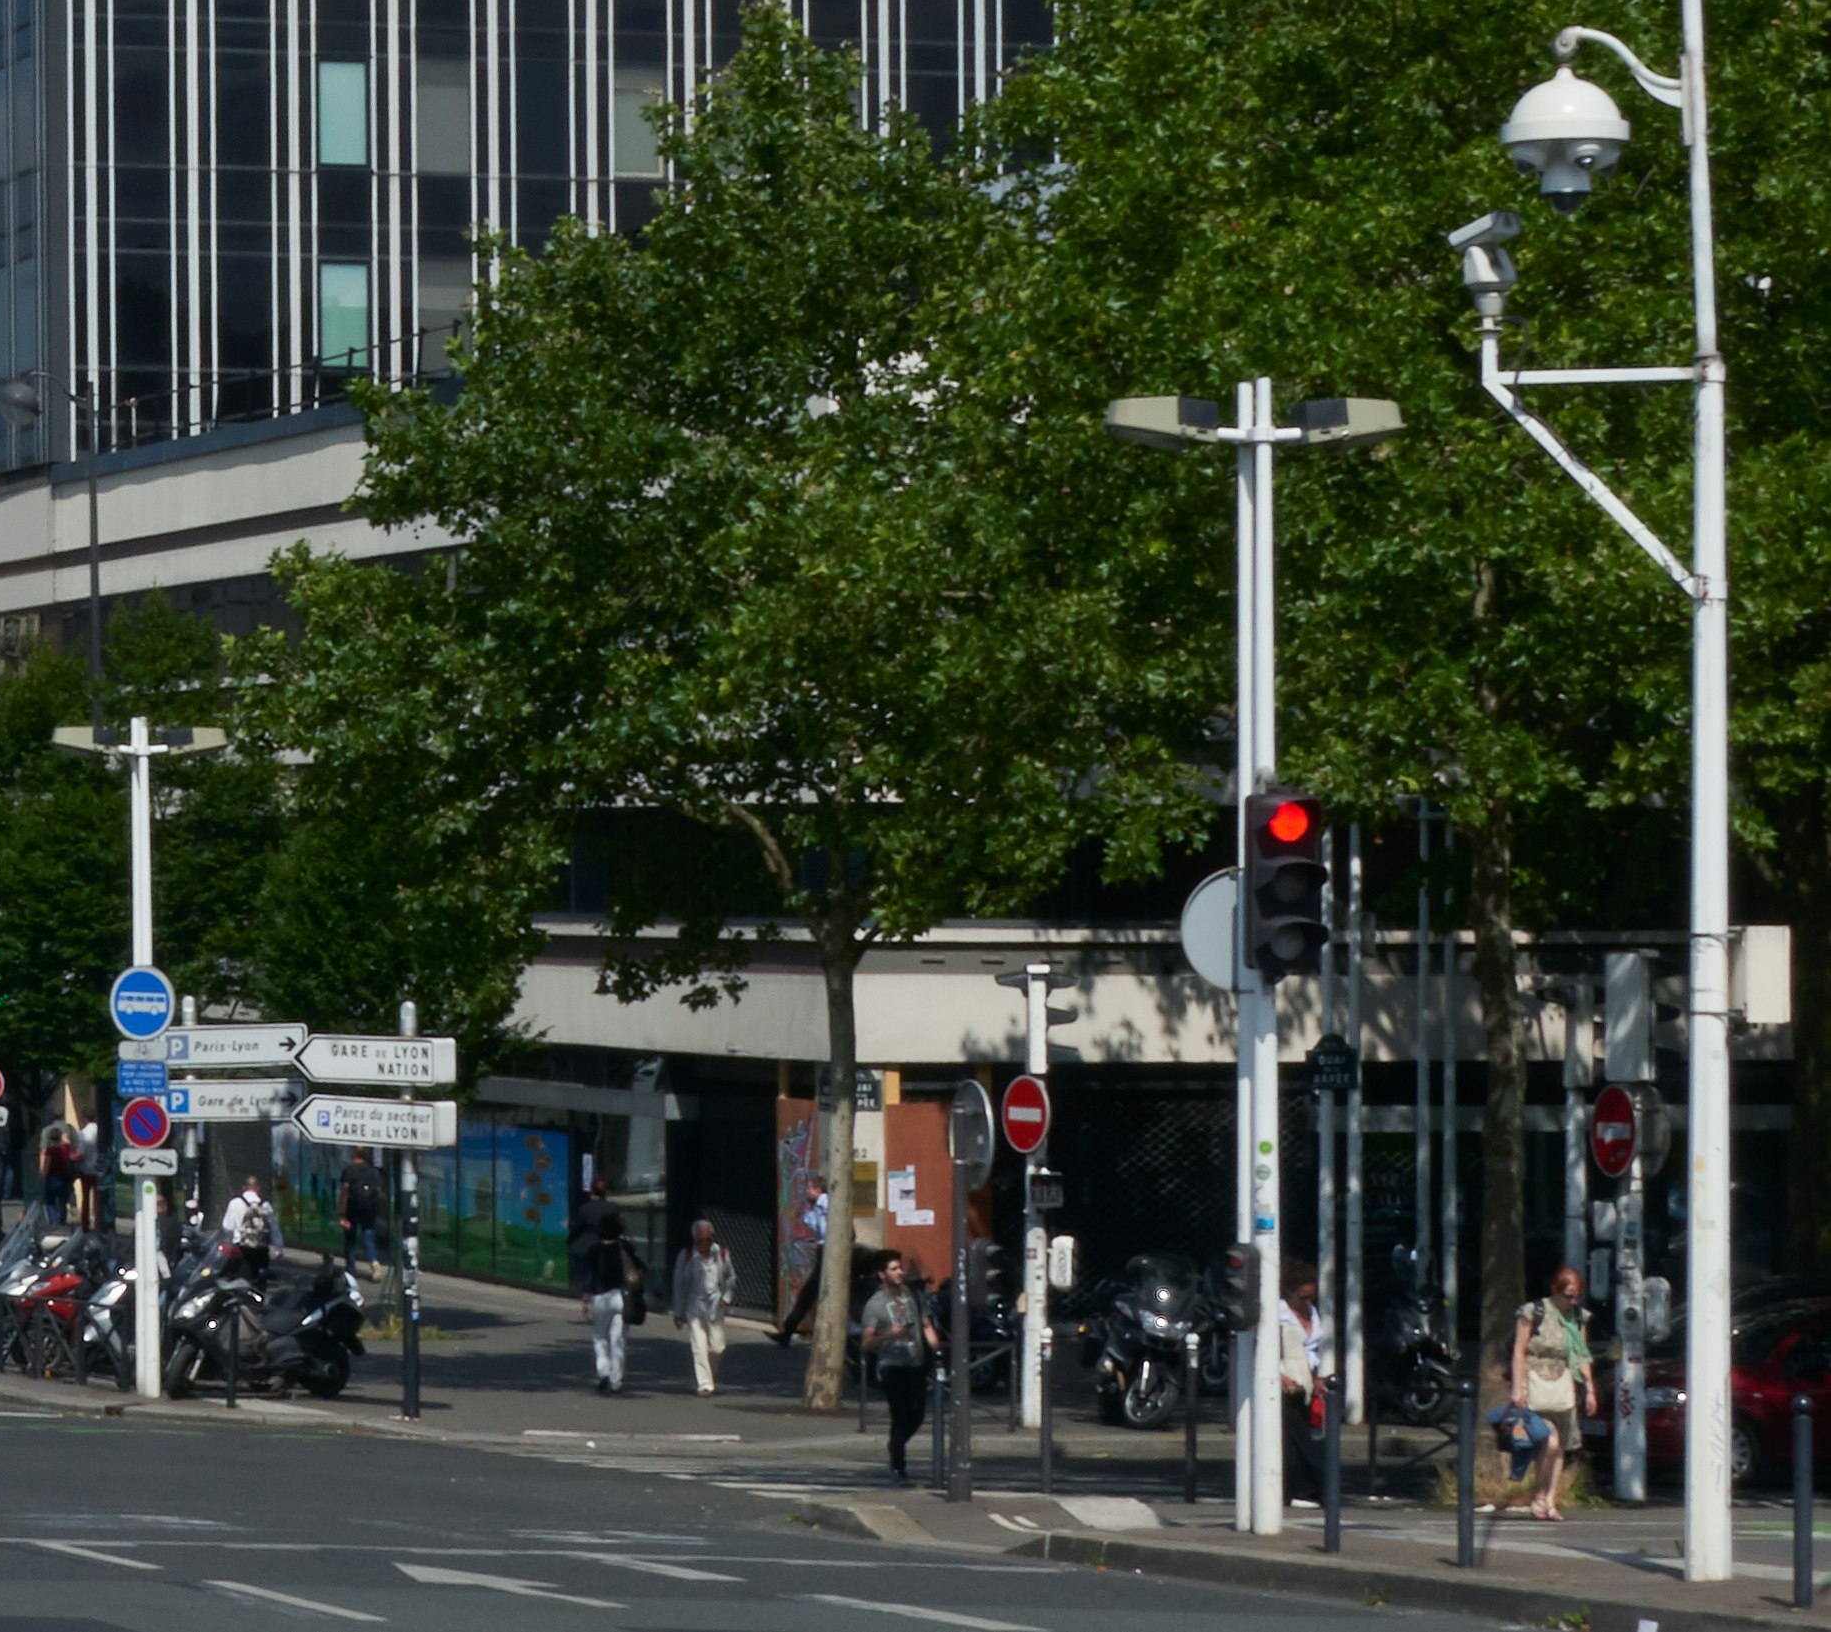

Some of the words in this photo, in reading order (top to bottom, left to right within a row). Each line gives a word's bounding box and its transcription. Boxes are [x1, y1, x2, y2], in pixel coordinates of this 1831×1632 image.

[171, 1038, 184, 1057] P
[194, 1040, 260, 1052] Paris-Lyon
[331, 1044, 368, 1058] GARE
[394, 1046, 429, 1059] LYON
[377, 1062, 429, 1076] NATION
[171, 1092, 185, 1110] P
[198, 1096, 224, 1107] Gare
[231, 1095, 244, 1107] de
[334, 1105, 366, 1120] Parcs
[369, 1107, 382, 1121] du
[387, 1110, 431, 1124] secteur
[333, 1123, 367, 1137] GARE
[386, 1125, 418, 1140] LYON
